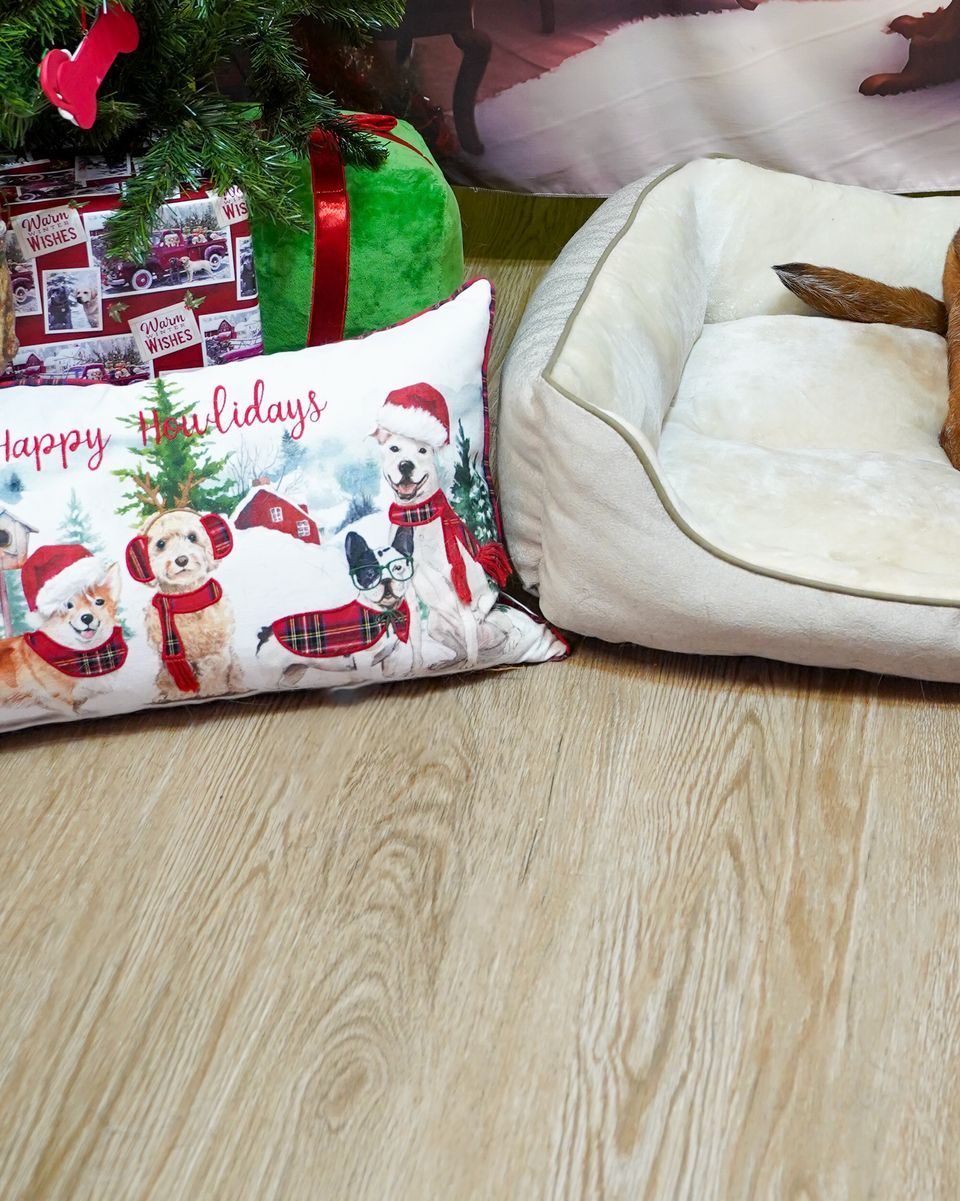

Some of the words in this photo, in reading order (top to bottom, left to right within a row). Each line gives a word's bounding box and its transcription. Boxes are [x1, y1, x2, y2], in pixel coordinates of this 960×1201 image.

[21, 211, 70, 232] Warm
[222, 202, 248, 220] WIS
[28, 220, 69, 237] WINTER
[26, 227, 78, 252] WISHES
[140, 314, 186, 335] Warm
[144, 328, 193, 354] WISHES
[139, 379, 327, 447] Howlidays
